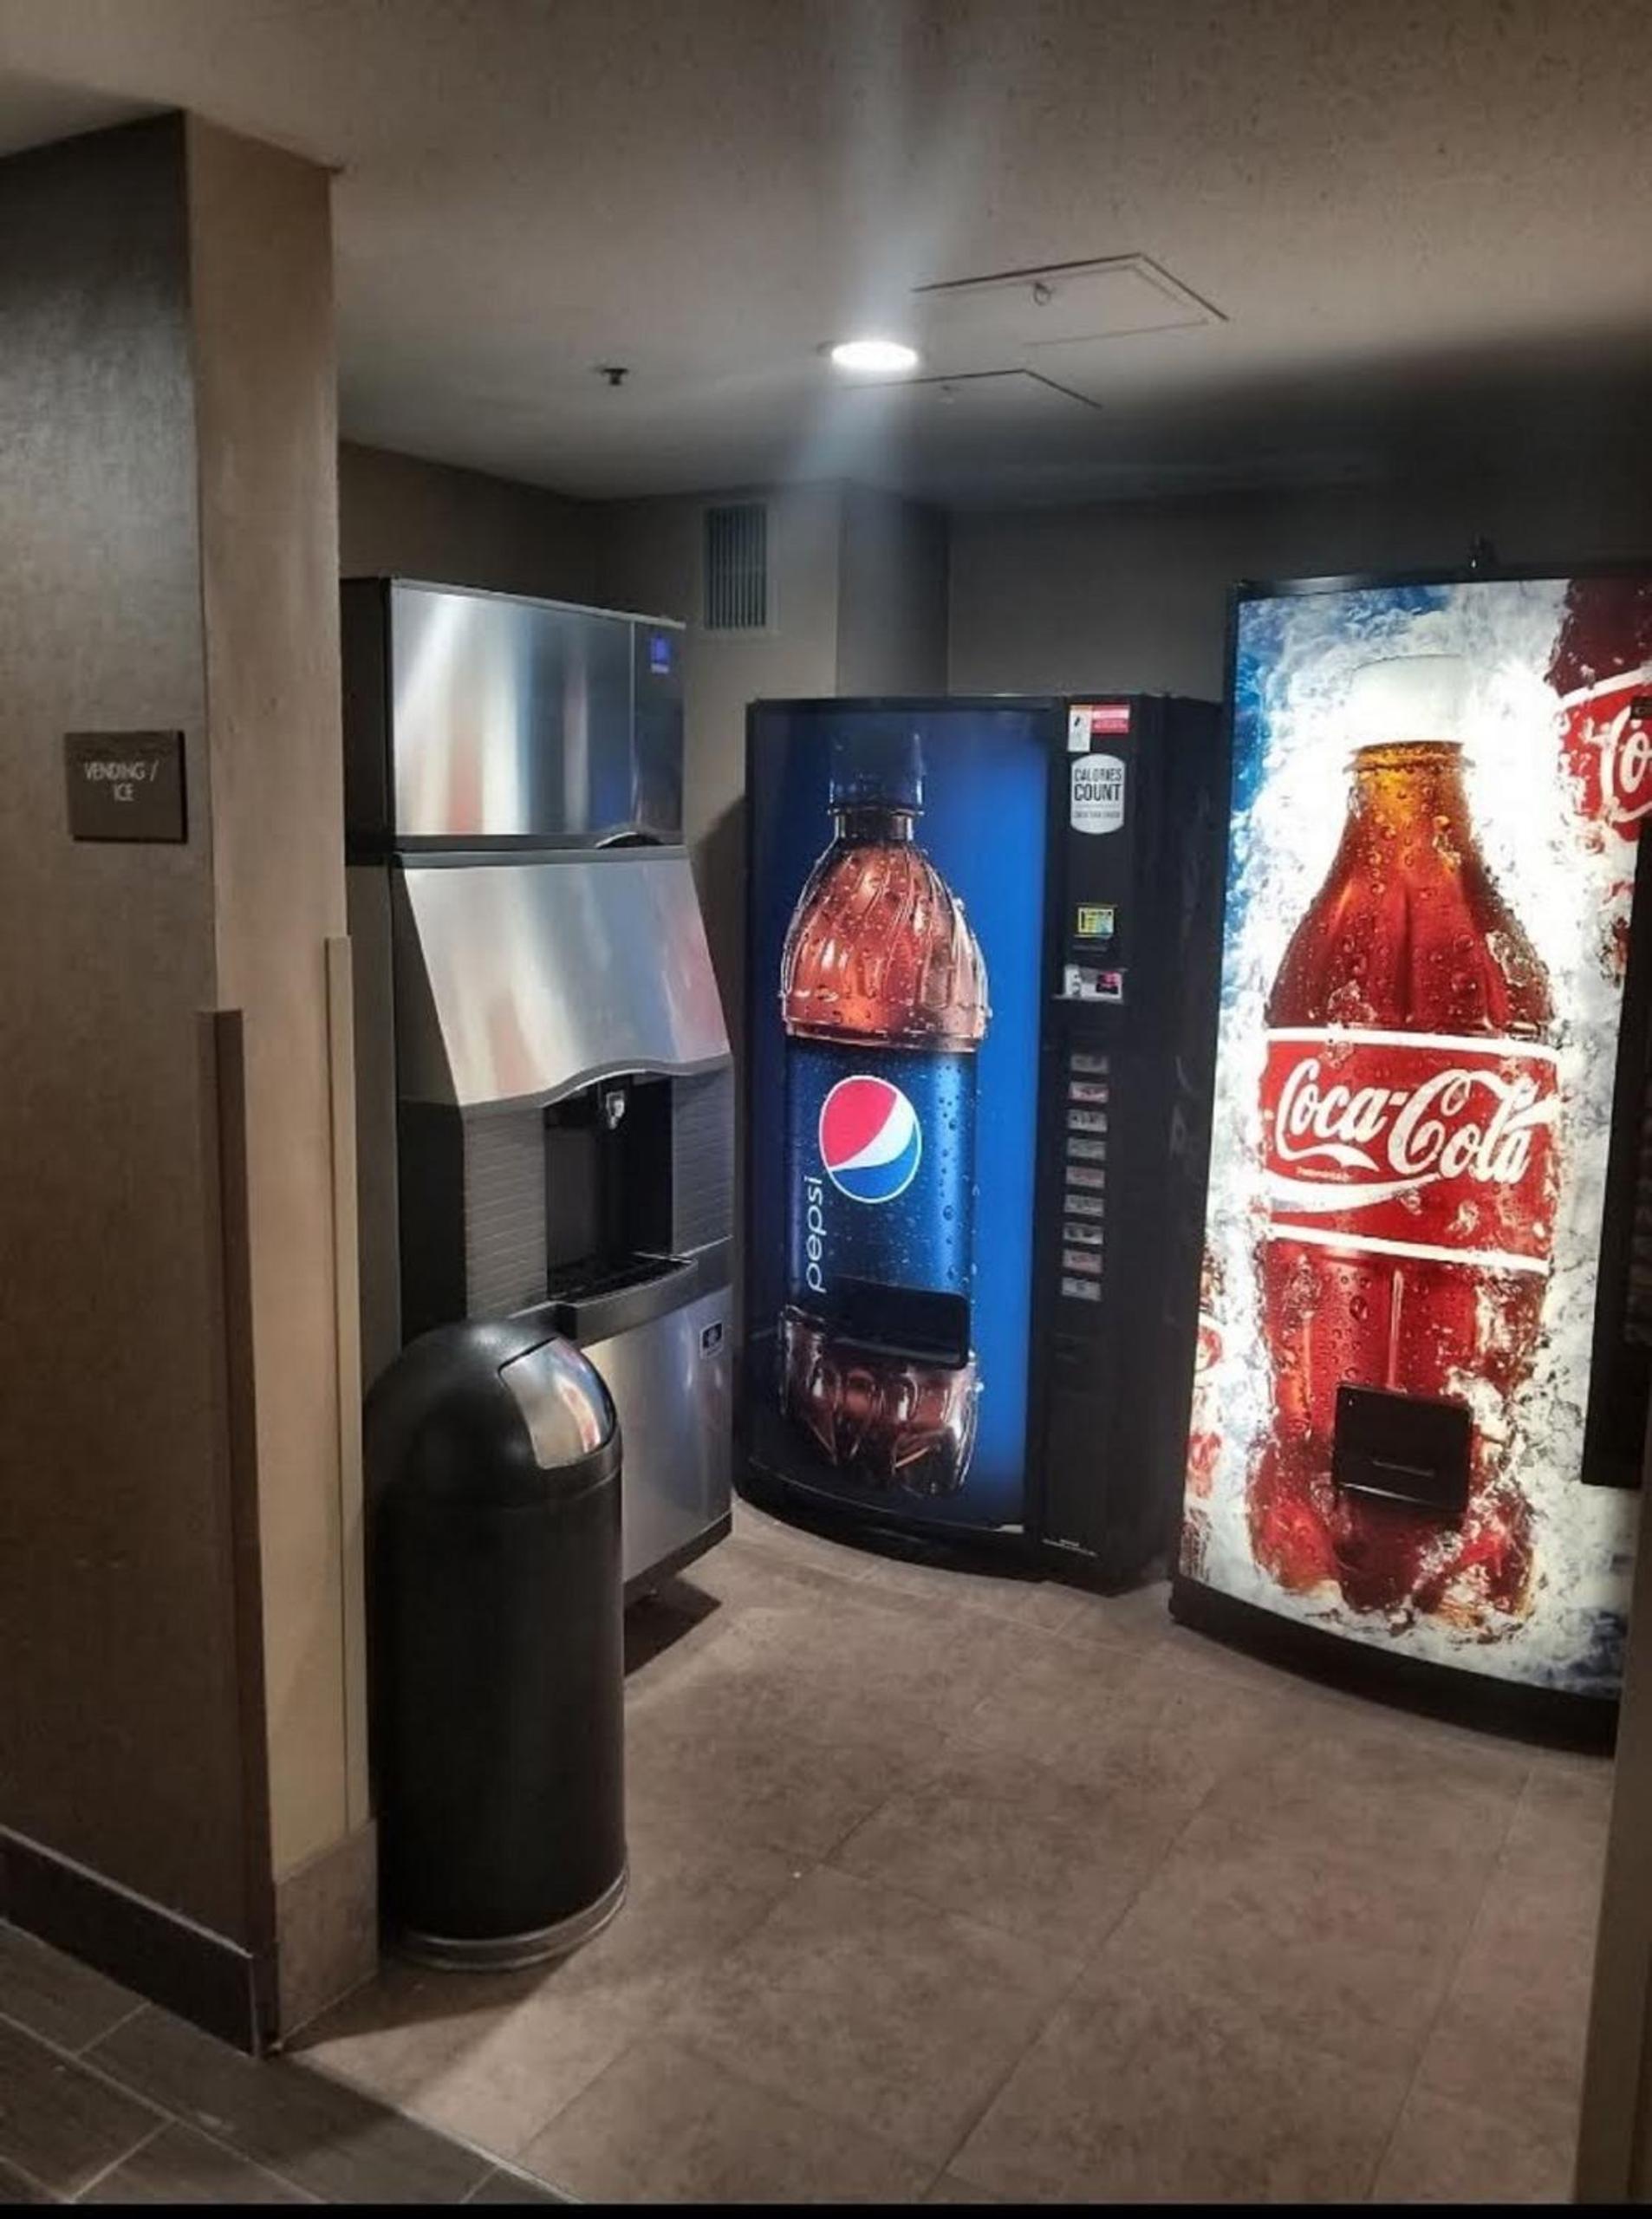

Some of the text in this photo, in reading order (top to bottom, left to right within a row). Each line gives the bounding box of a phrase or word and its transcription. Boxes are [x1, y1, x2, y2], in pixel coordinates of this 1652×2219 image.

[84, 761, 146, 781] VENDING
[1073, 767, 1122, 783] CALORIES
[113, 783, 134, 802] ICE
[1073, 784, 1122, 802] COUNT
[1275, 1057, 1563, 1184] Coca-Cola
[803, 1175, 827, 1293] pepsi
